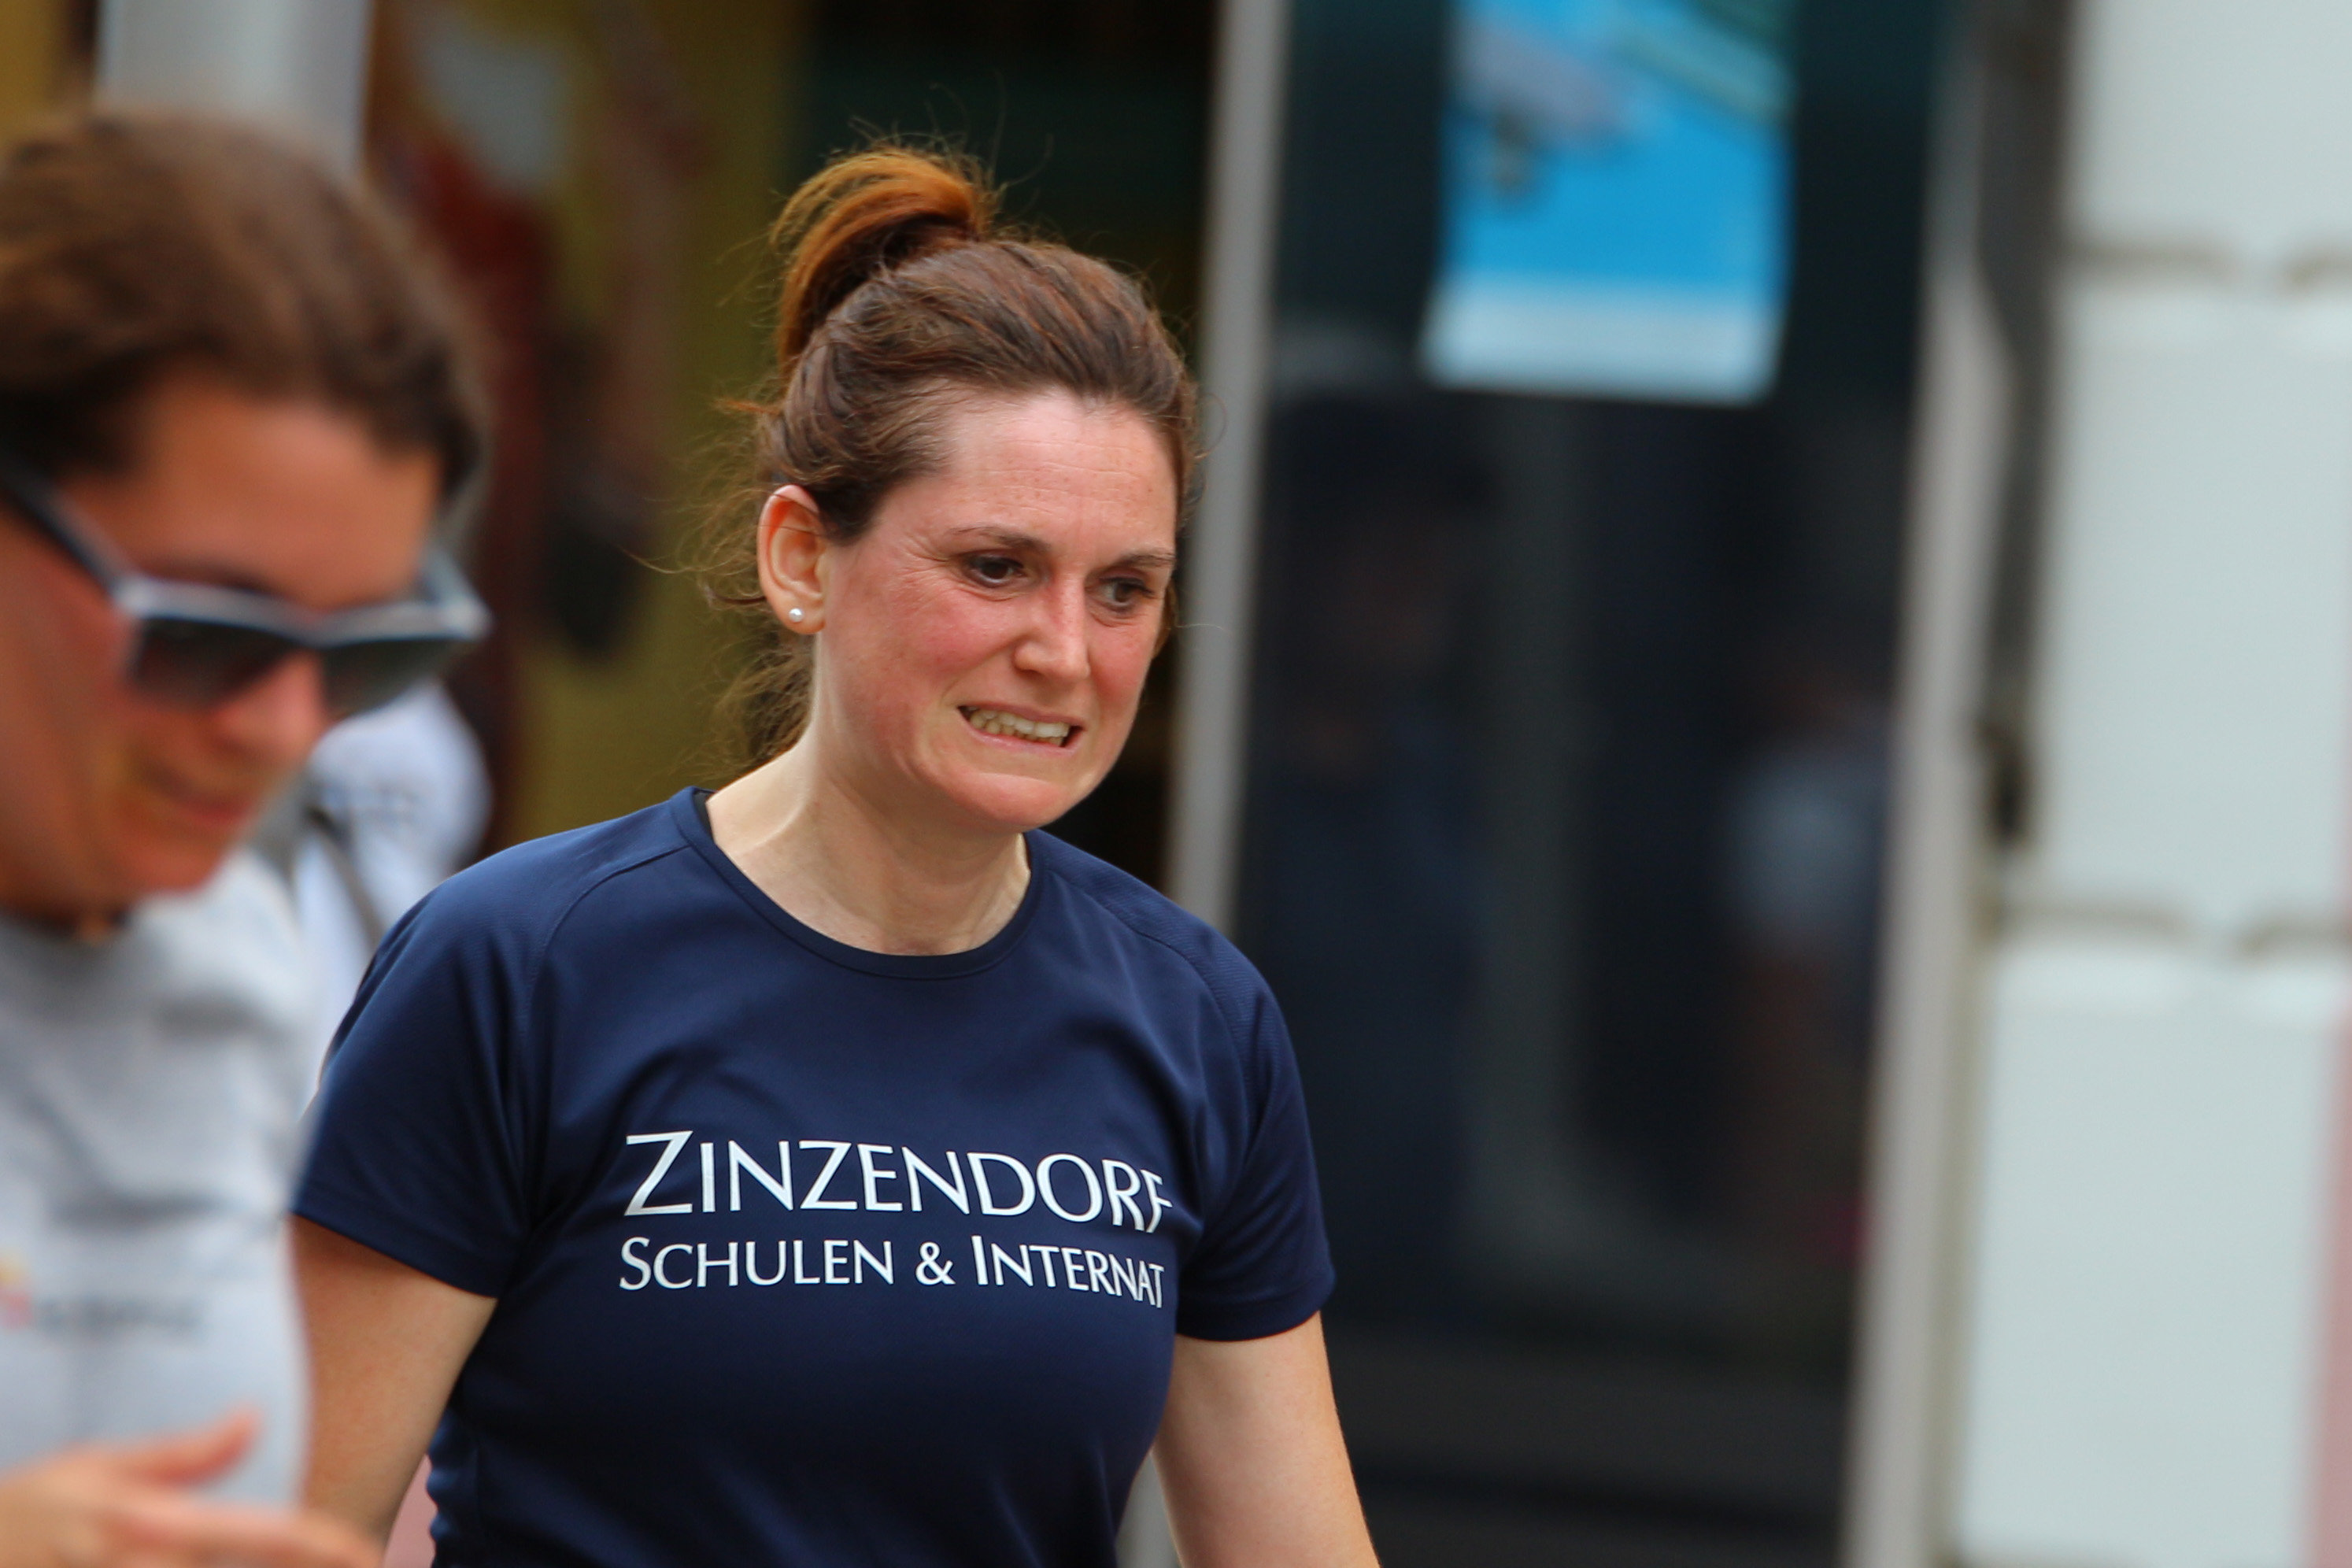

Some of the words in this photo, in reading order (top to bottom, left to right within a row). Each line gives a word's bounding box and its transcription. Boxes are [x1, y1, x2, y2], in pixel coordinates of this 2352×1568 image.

[624, 1130, 1173, 1233] ZINZENDORF
[619, 1237, 894, 1290] SCHULEN
[915, 1241, 956, 1285] &
[971, 1235, 1165, 1308] INTERNAT
